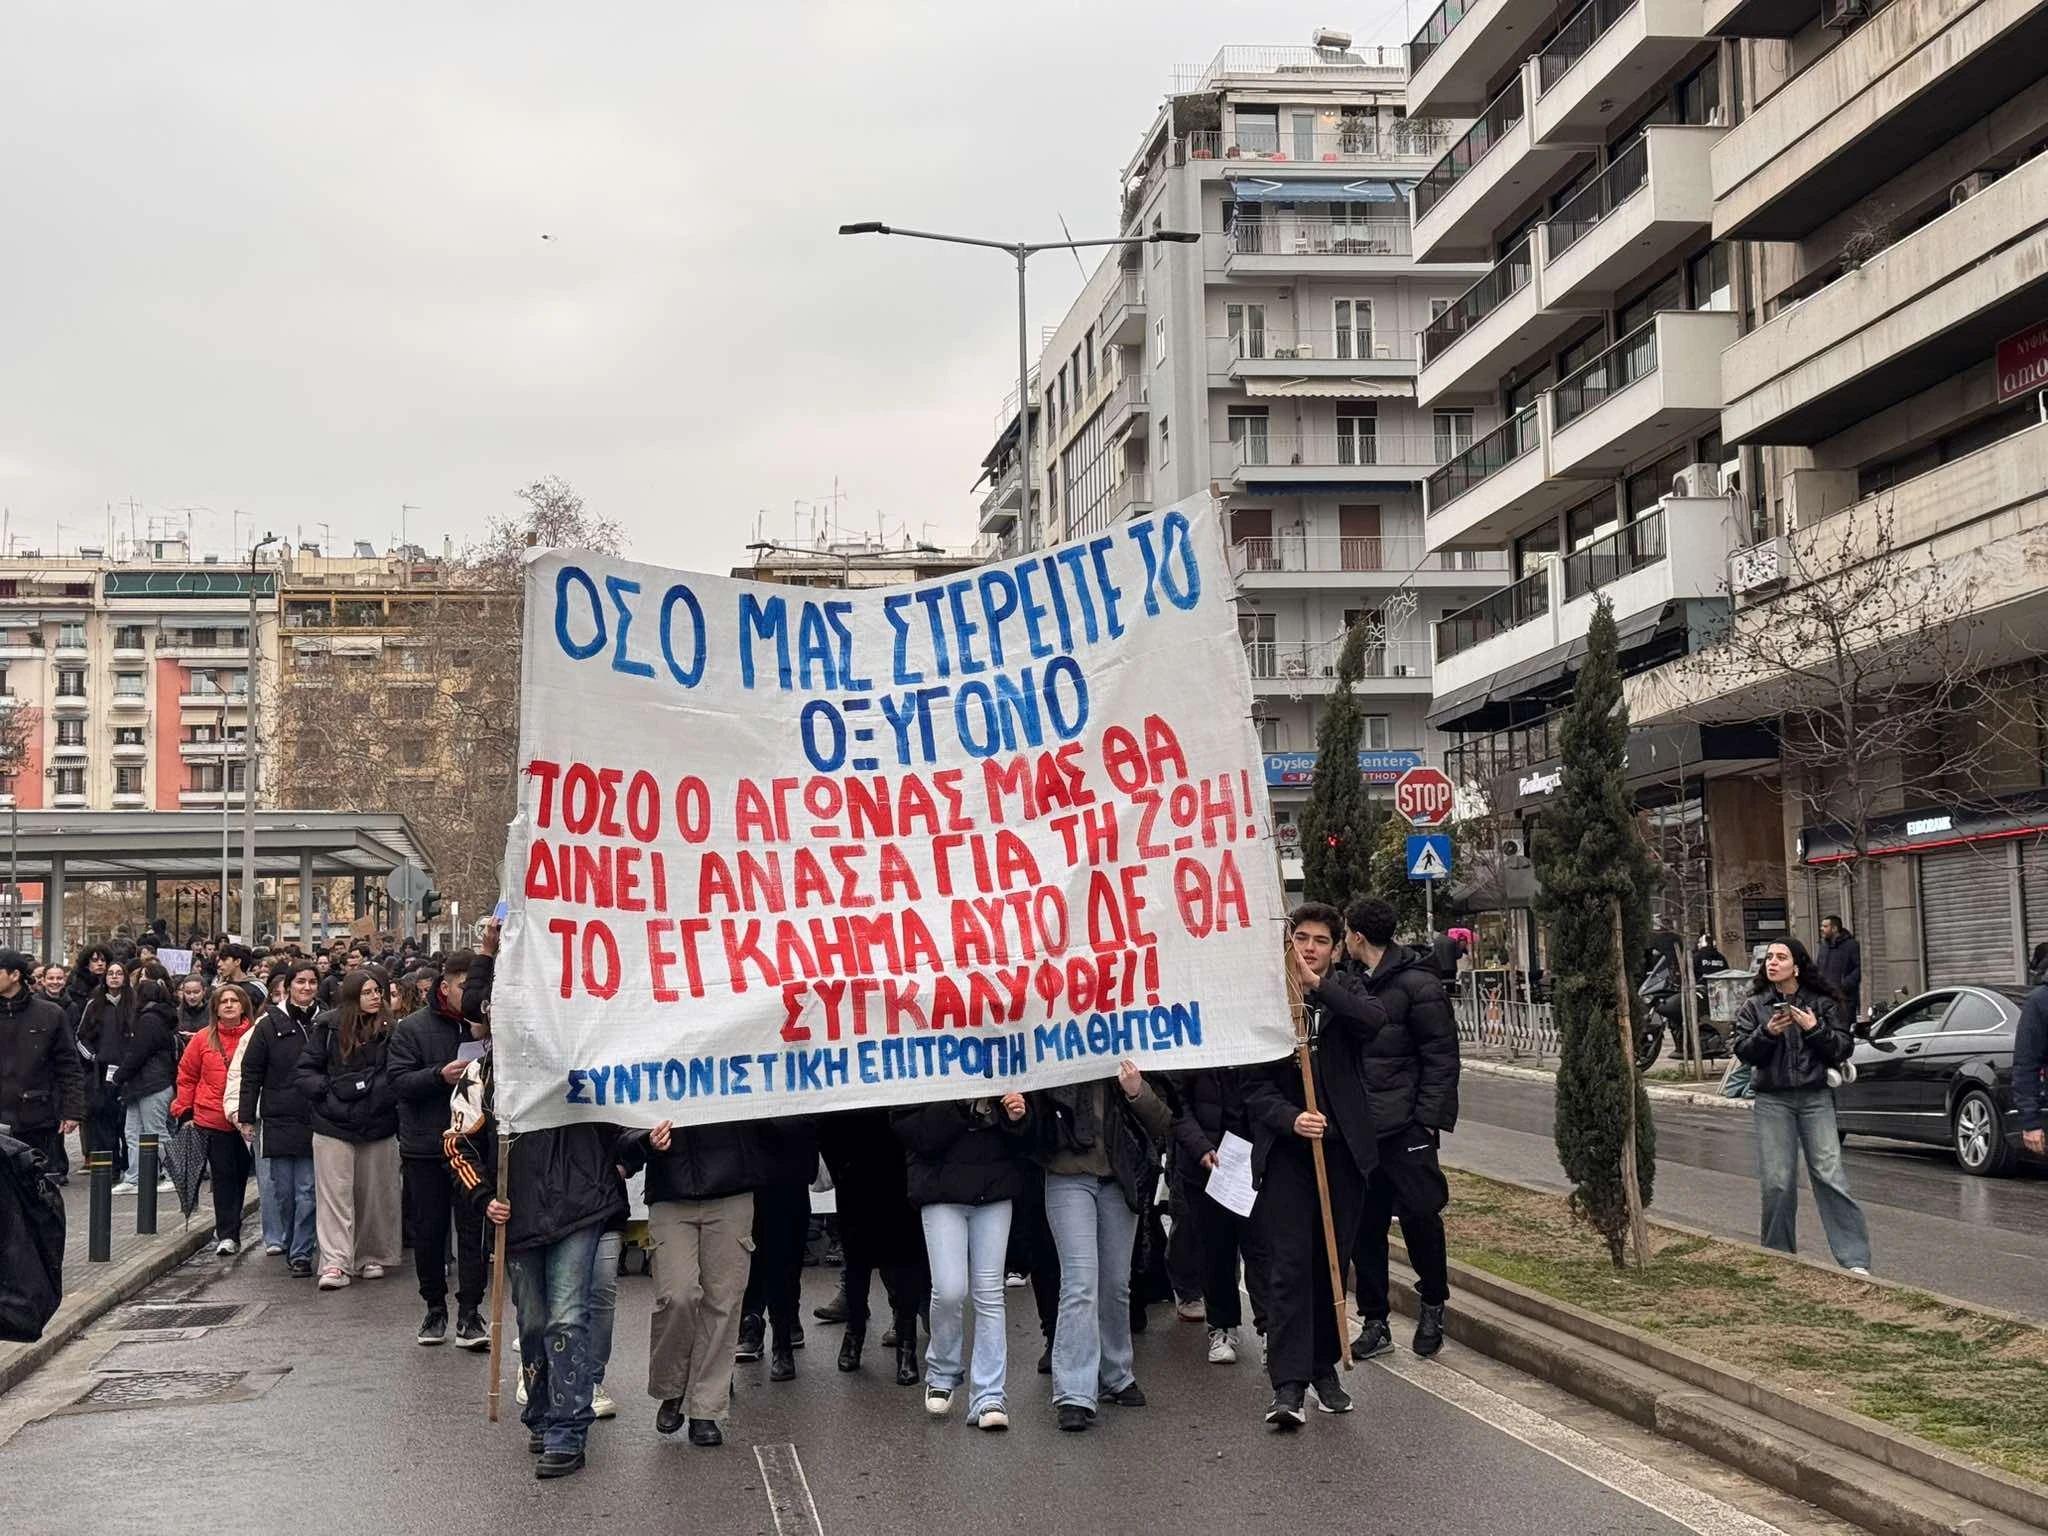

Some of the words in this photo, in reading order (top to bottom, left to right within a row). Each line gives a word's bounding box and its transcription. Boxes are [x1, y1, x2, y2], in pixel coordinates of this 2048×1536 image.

[555, 566, 707, 689] ΟΣΟ
[739, 593, 873, 690] ΜΑΣ
[884, 536, 1125, 686] ΣΤΕΡΕΙΤΕ
[1128, 511, 1202, 617] ΤΟ
[800, 655, 1090, 773] ΟΞΥΓΟΝΟ
[1271, 757, 1318, 770] Dyslex
[1358, 755, 1414, 768] enters
[524, 760, 660, 843] ΤΟΣΟ
[675, 775, 711, 844] Ο
[736, 770, 974, 842] ΑΓΩΝΑΣ
[982, 741, 1097, 825] ΜΑΣ
[1102, 714, 1189, 795] ΘΑ
[1401, 783, 1450, 812] STOP
[525, 838, 667, 913] ΔΙΝΕΙ
[699, 842, 921, 915] ΑΝΑΣΑ
[932, 829, 1042, 897] ΓΙΑ
[1050, 801, 1118, 867] ΤΗ
[1131, 769, 1256, 860] ΖΩΗ!
[549, 918, 621, 1000] ΤΟ
[647, 909, 944, 1002] ΕΓΚΛΗΜΑ
[951, 884, 1070, 969] ΑΥΤΟ
[1088, 864, 1158, 954] ΔΕ
[1174, 849, 1252, 940] ΘΑ
[566, 1048, 848, 1105] ΣΥΝΤΟΝΙΣΤΙΚΗ
[858, 1034, 1026, 1083] ΕΠΙΤΡΟΠΗ
[1034, 1001, 1202, 1064] ΜΑΘΗΤΩΝ
[780, 947, 1160, 1042] ΣΥΓΚΑΛΥΦΘΕΙ!
